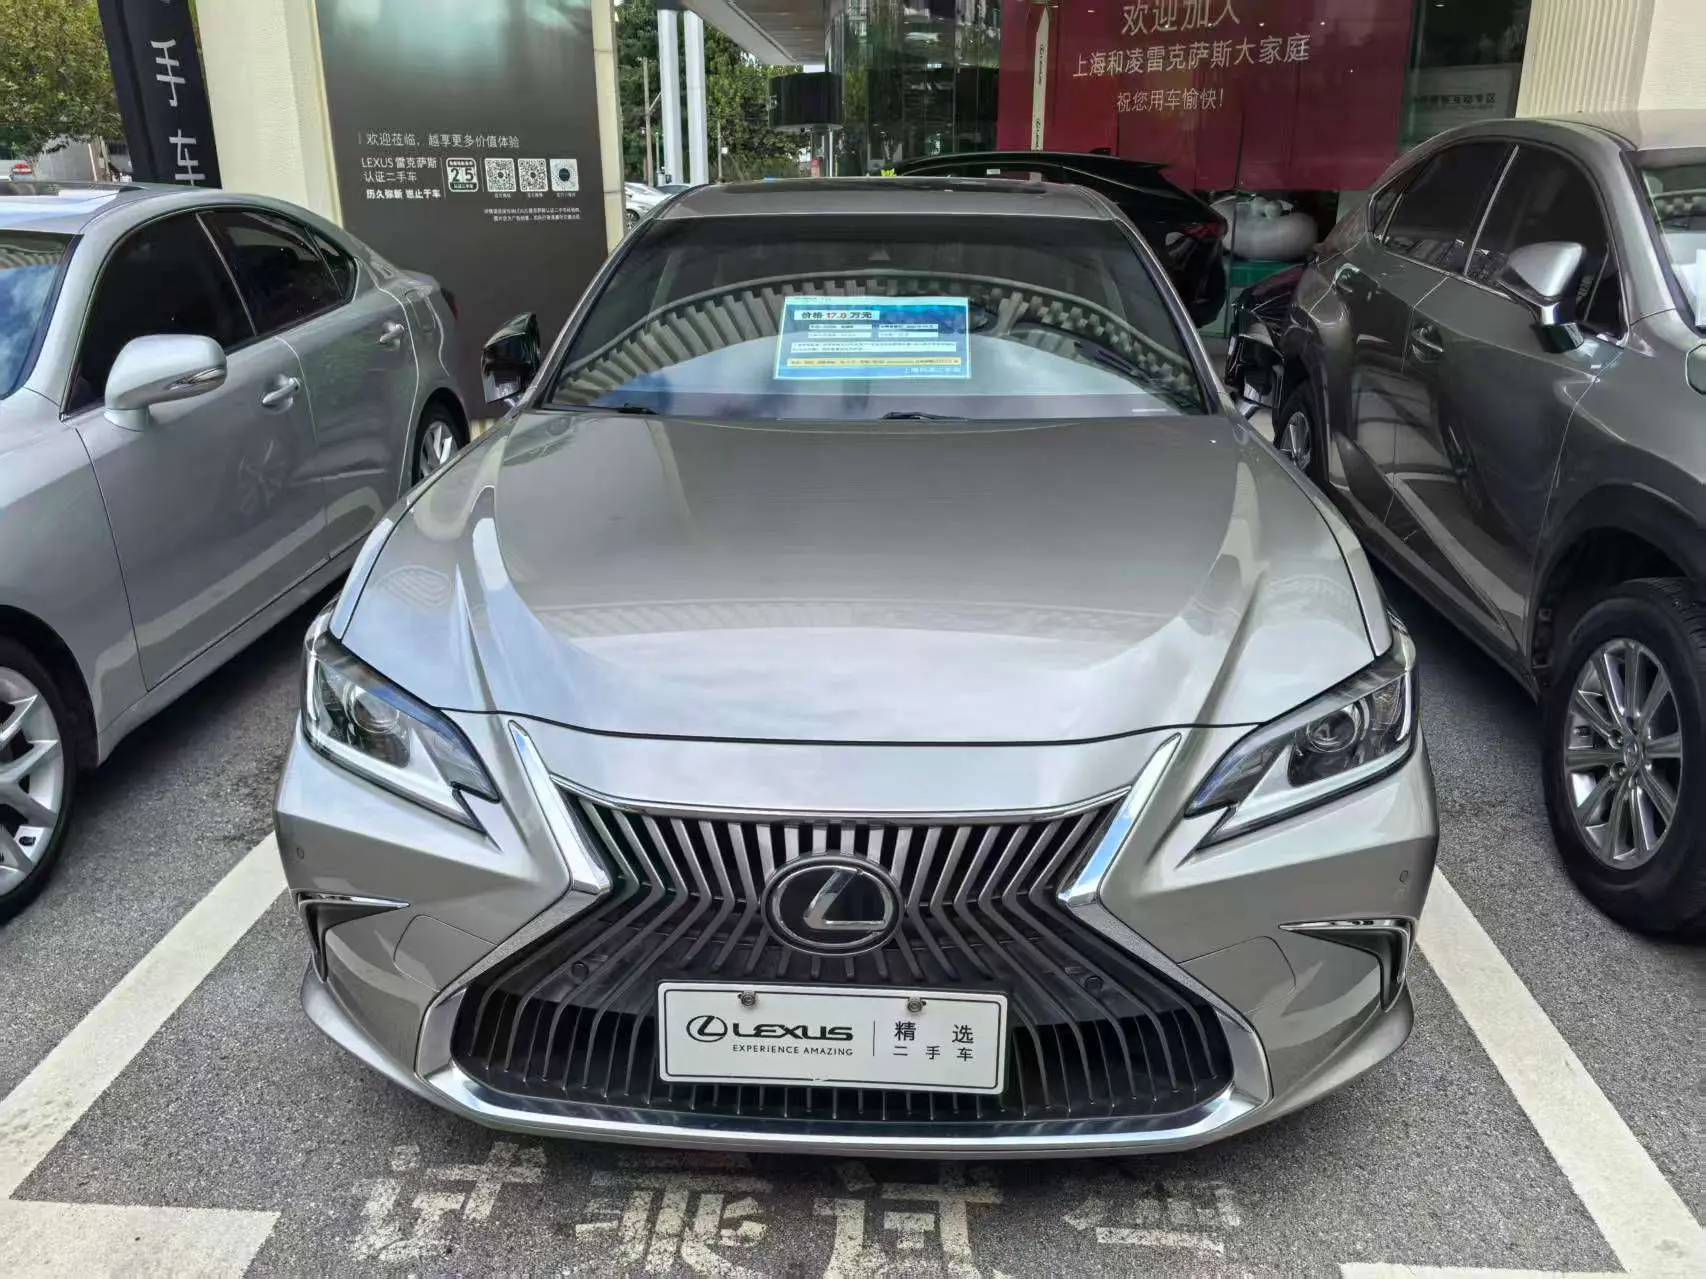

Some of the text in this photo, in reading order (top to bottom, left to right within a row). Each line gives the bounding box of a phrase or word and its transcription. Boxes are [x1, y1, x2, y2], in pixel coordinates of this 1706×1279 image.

[1072, 32, 1311, 78] 上海和凌雷克萨斯大家庭
[361, 157, 394, 169] LEXUS
[395, 157, 437, 169] 雷克萨斯
[364, 171, 417, 183] 认证二手车
[732, 1022, 854, 1042] LEXUS
[894, 1021, 974, 1044] 精选
[732, 1044, 854, 1056] EXPERIENCE AMAZING
[893, 1045, 974, 1062] 二手车
